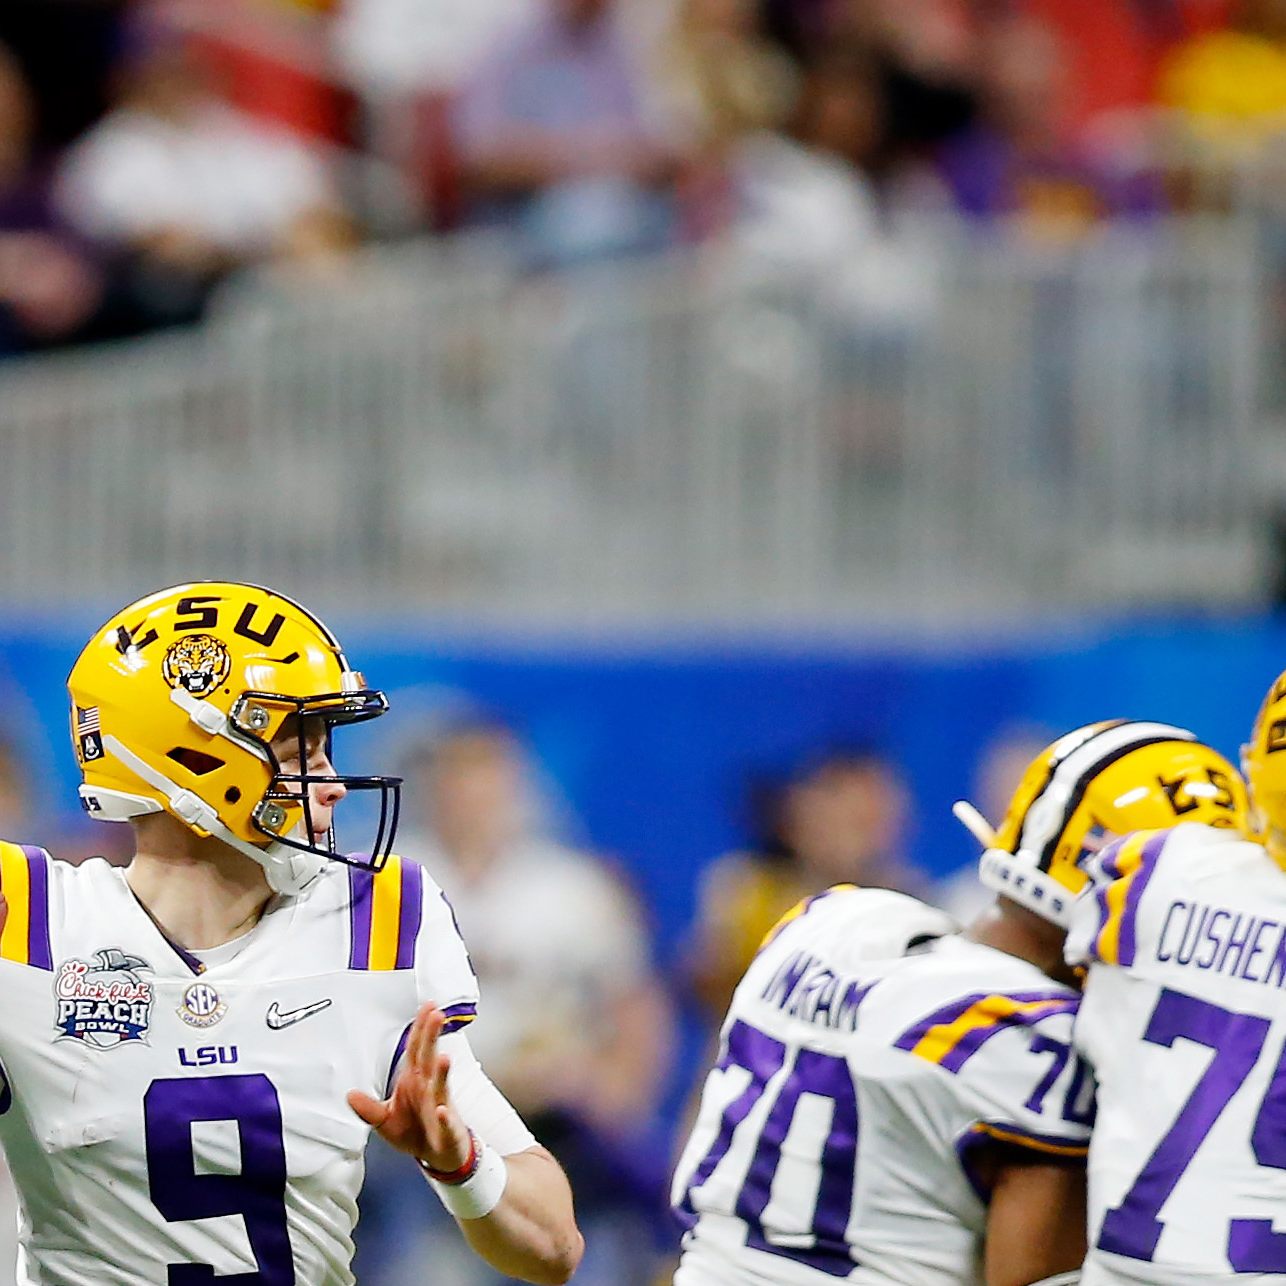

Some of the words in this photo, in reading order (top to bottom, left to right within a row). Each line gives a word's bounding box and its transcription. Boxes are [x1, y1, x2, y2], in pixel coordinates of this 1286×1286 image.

[115, 596, 287, 655] LSU
[59, 1000, 149, 1027] PEACH
[186, 985, 219, 1016] SEC
[75, 1021, 130, 1034] BOWL
[178, 1046, 239, 1067] LSU
[671, 1017, 861, 1277] 70
